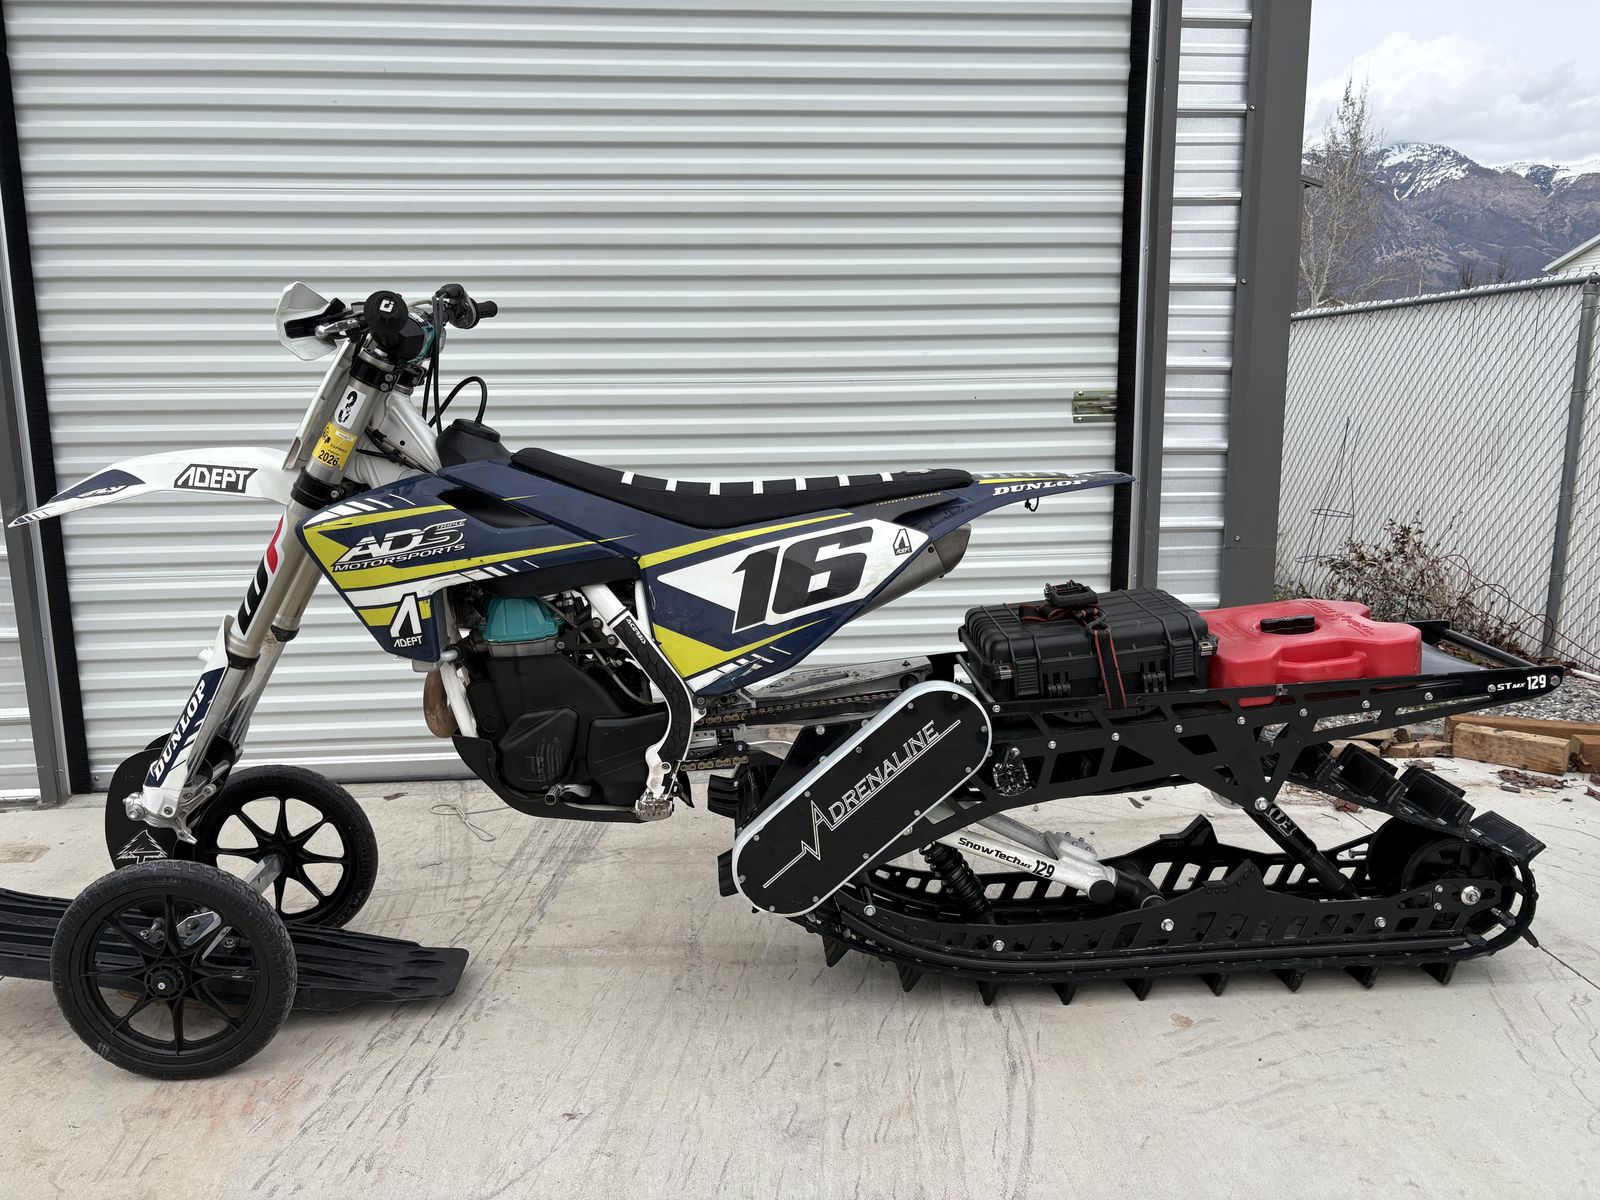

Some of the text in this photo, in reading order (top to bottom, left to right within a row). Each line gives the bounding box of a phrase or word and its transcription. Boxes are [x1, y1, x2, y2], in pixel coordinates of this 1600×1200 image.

[318, 449, 340, 466] 2026
[177, 466, 252, 490] ADEPT
[993, 479, 1088, 496] DUNLOP
[337, 519, 466, 562] ADS
[334, 543, 466, 571] MOTORSPORTS
[731, 525, 874, 631] 16
[393, 635, 423, 648] ADEPT
[1526, 674, 1547, 690] 129
[150, 679, 206, 781] DUNLOP
[809, 719, 940, 848] ADRENALINE
[1032, 859, 1056, 878] 129
